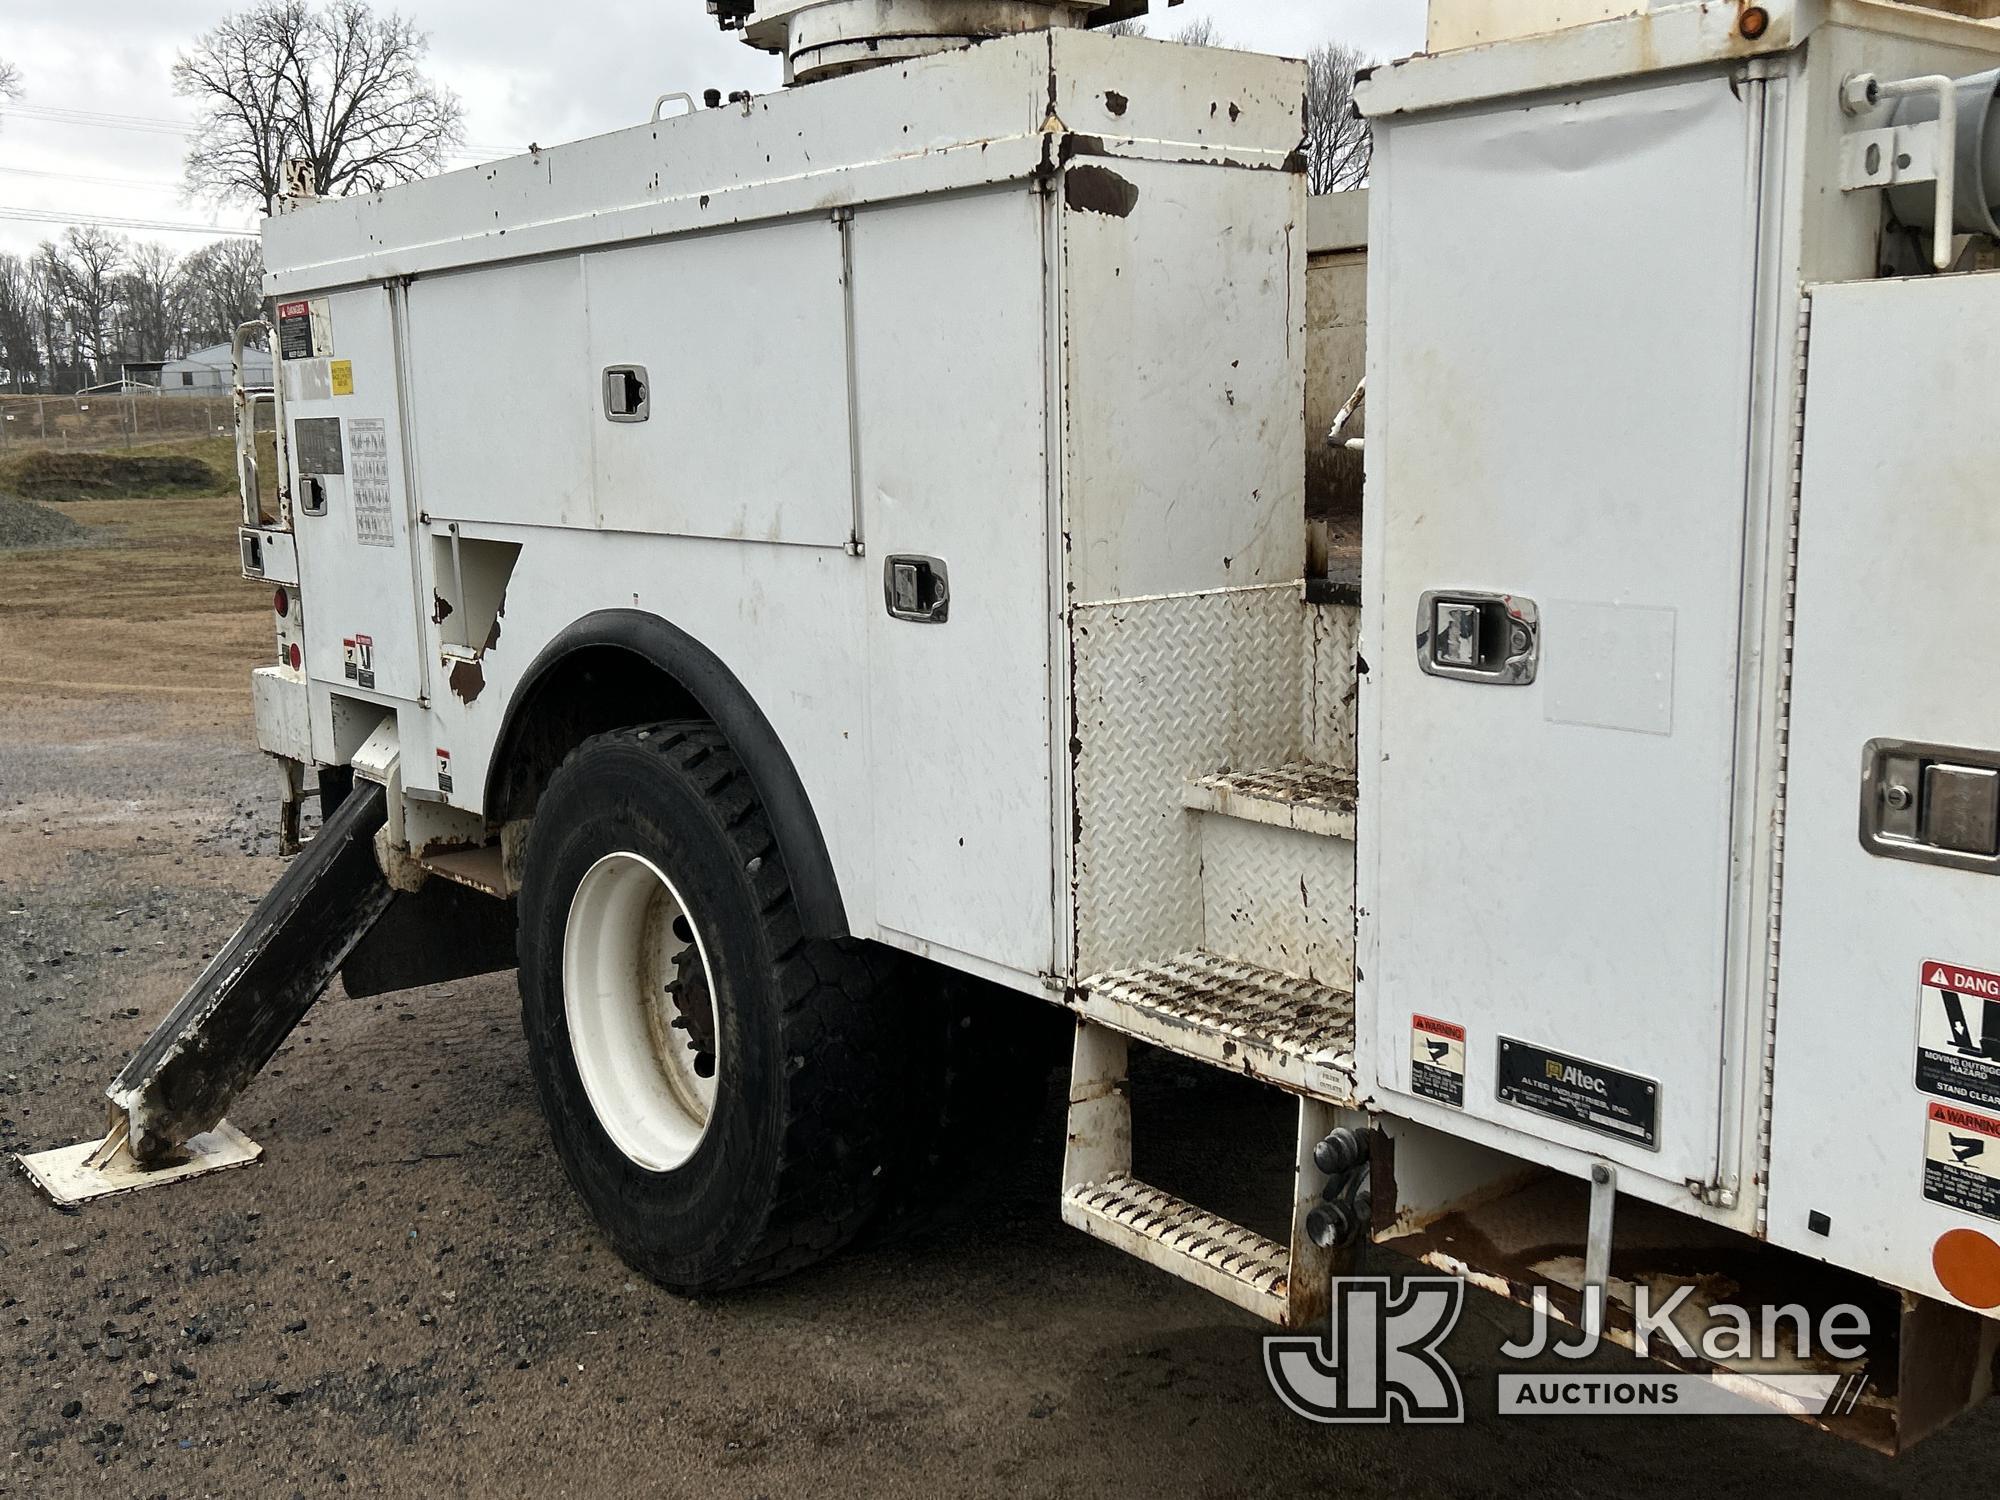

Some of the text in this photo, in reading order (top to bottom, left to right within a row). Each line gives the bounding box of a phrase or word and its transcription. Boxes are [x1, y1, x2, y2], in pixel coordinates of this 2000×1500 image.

[1954, 972, 1999, 996] DANG
[1424, 1019, 1463, 1040] WARNING
[1924, 1050, 1960, 1066] MOVING
[1562, 1065, 1606, 1094] Altec
[1950, 1065, 1988, 1080] HAZARD
[1521, 1076, 1550, 1091] ALTEC
[1611, 1104, 1632, 1117] INC.
[1936, 1082, 2000, 1106] STAND CLEAR
